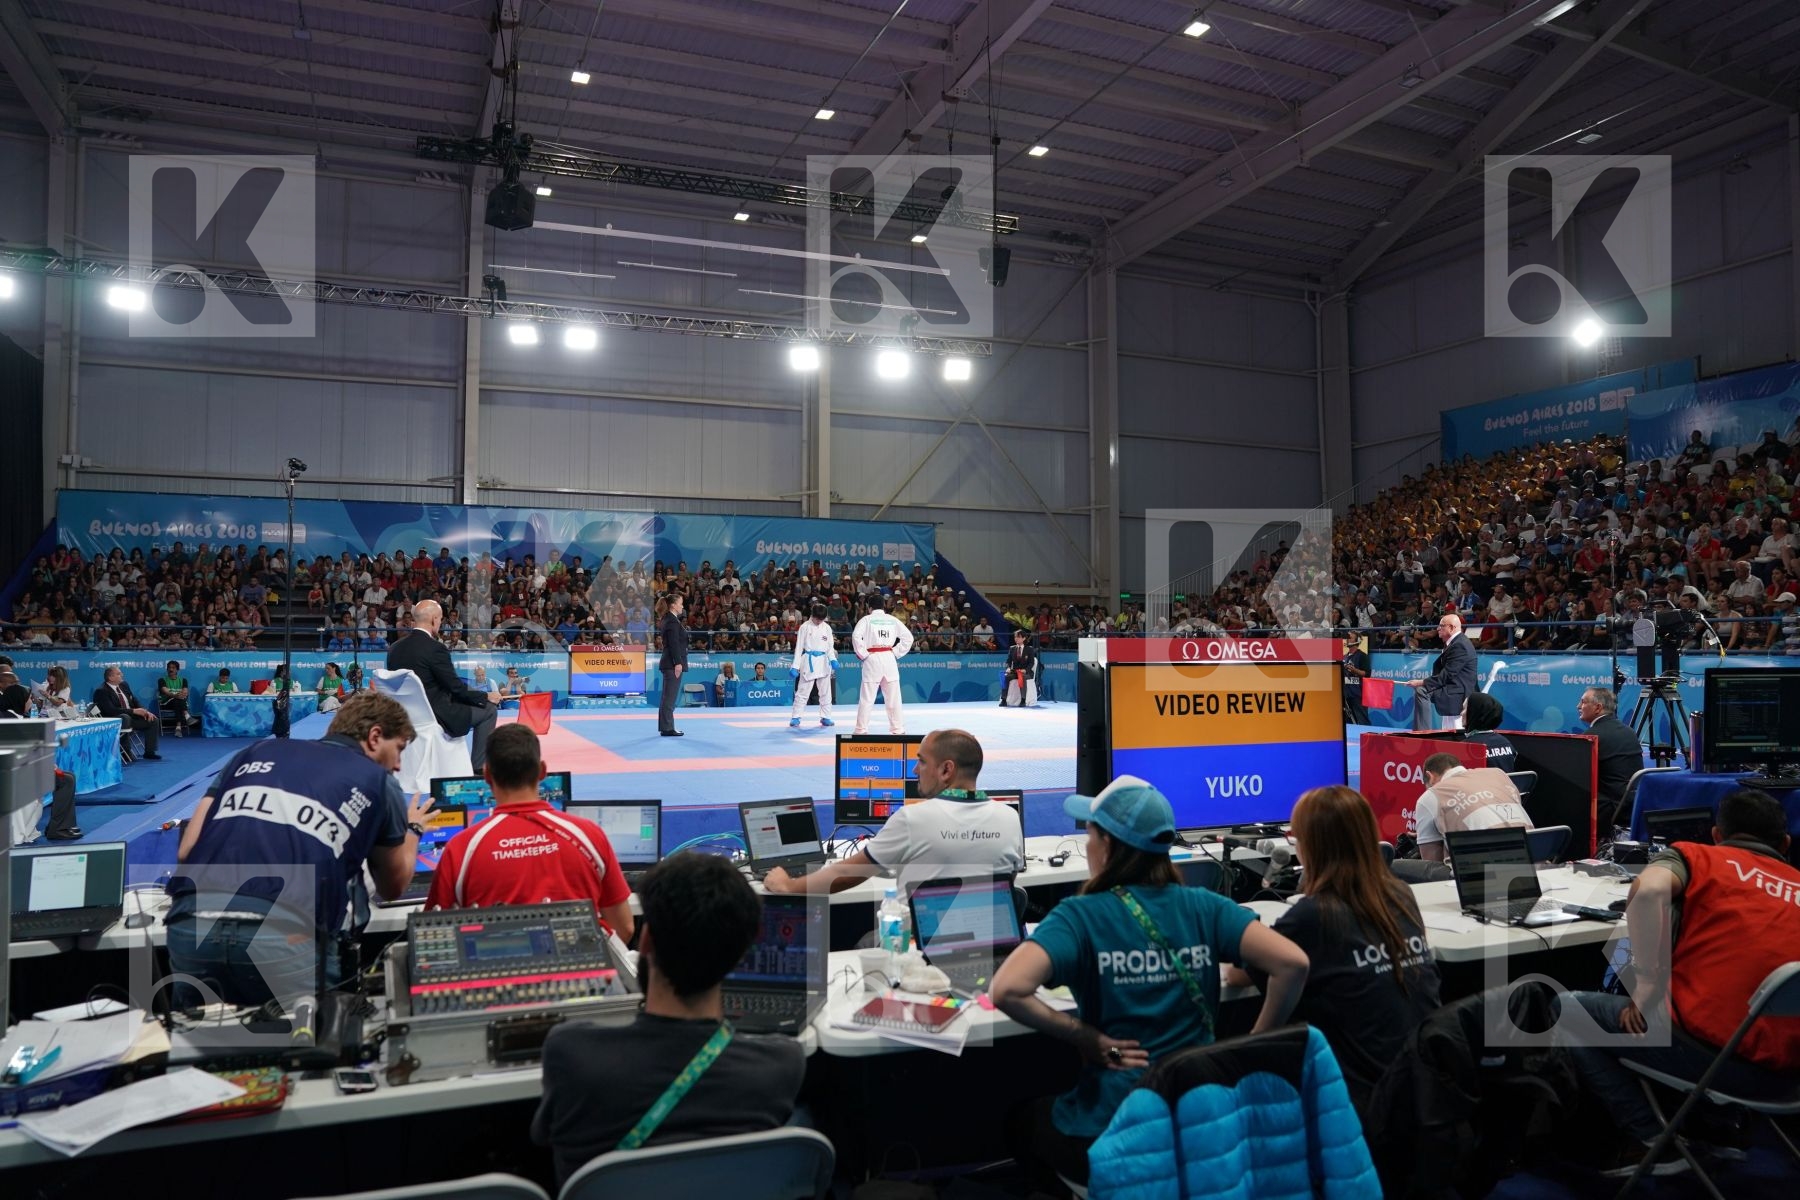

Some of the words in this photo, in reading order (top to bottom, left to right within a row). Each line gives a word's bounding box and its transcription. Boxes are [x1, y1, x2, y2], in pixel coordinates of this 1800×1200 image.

[1532, 403, 1564, 422] AIRES
[1566, 397, 1596, 415] 2018
[1523, 426, 1542, 437] Feel
[1544, 423, 1560, 433] the
[1561, 419, 1590, 431] future
[166, 520, 213, 539] AIRES
[216, 523, 257, 540] 2018
[812, 542, 847, 557] AIRES
[849, 543, 880, 558] 2018
[1206, 641, 1278, 660] OMEGA
[747, 689, 781, 699] COACH
[1154, 694, 1220, 716] VIDEO
[1226, 692, 1306, 715] REVIEW
[234, 761, 276, 778] OBS
[1383, 761, 1425, 784] COA
[1205, 774, 1263, 799] YUKO
[1447, 790, 1467, 808] OIS
[1453, 790, 1495, 816] PHOTO
[222, 791, 273, 815] ALL
[296, 804, 340, 843] 073
[498, 833, 551, 848] OFFICIAL
[960, 830, 970, 840] el
[971, 829, 1001, 841] futuro
[491, 842, 560, 861] TIMEKEEPER
[1097, 944, 1213, 976] PRODUCER
